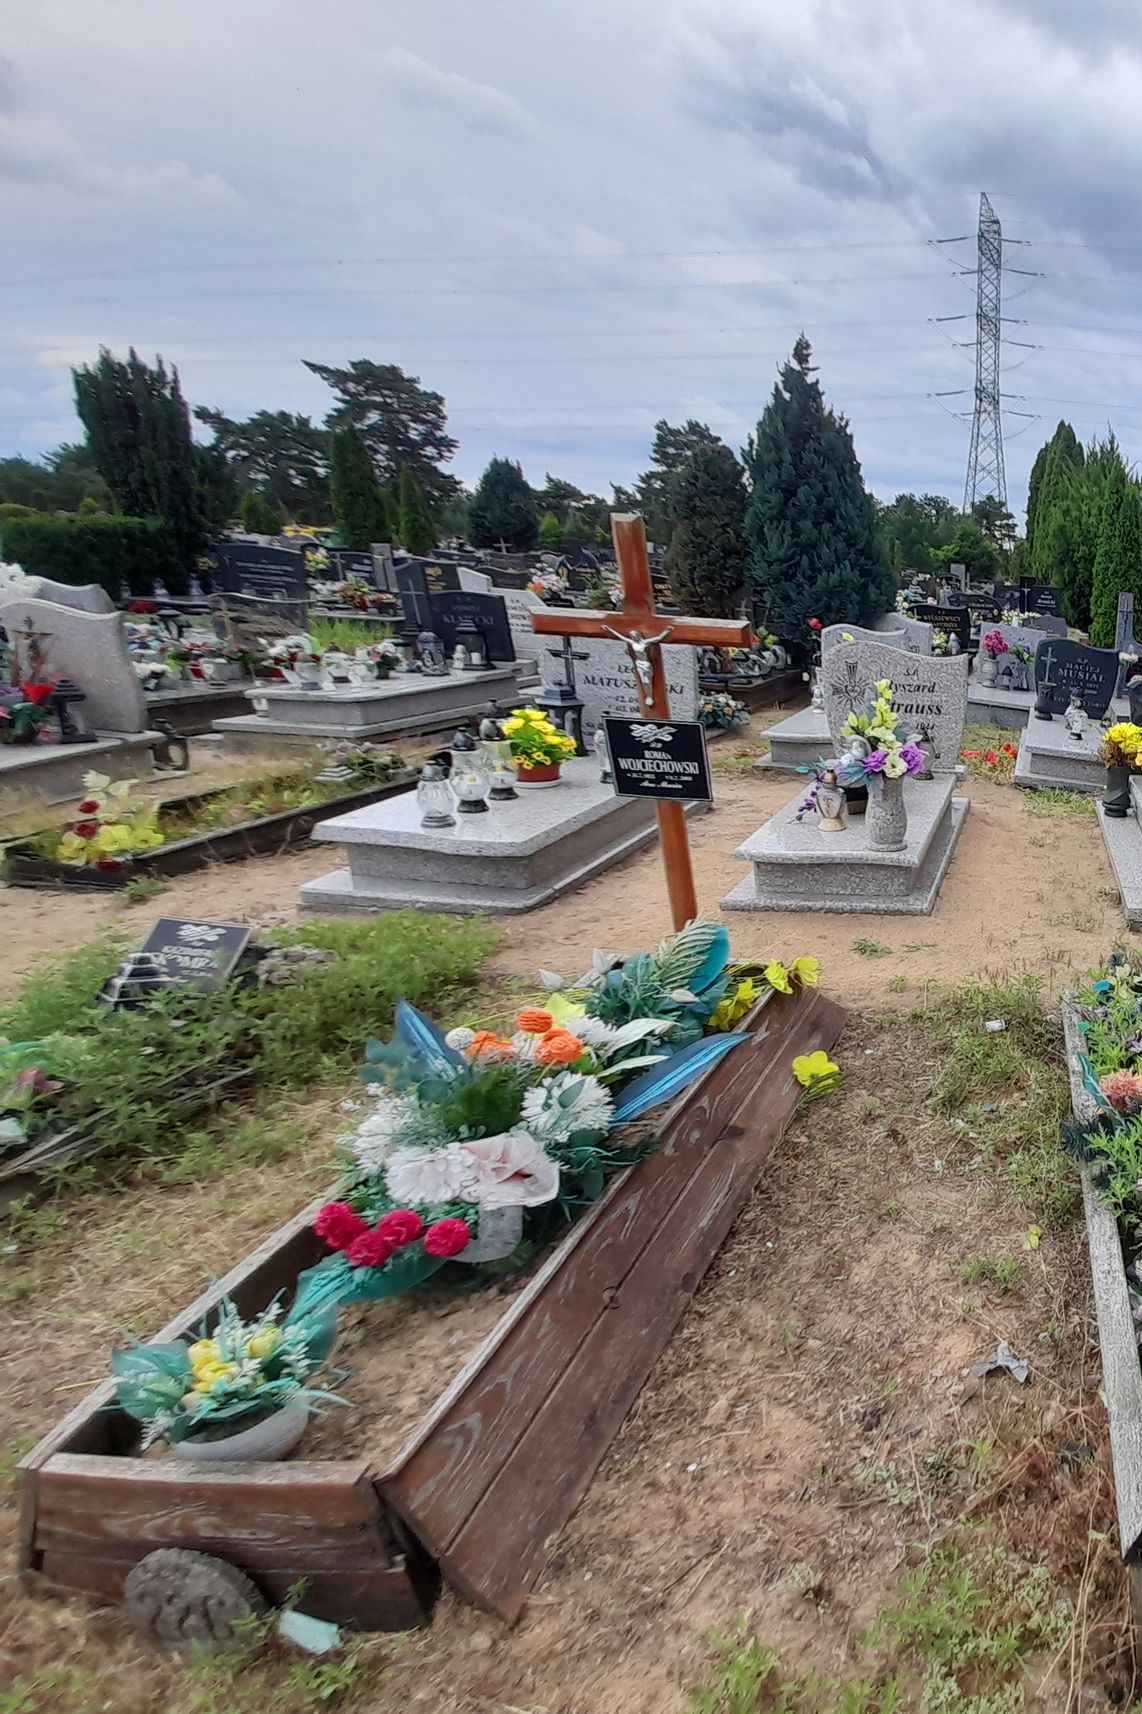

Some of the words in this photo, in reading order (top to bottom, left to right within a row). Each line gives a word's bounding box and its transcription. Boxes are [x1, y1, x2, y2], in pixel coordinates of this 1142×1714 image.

[886, 702, 943, 715] trauss
[643, 750, 672, 760] ROMAN
[617, 757, 700, 775] WOJCIECHOWSKI
